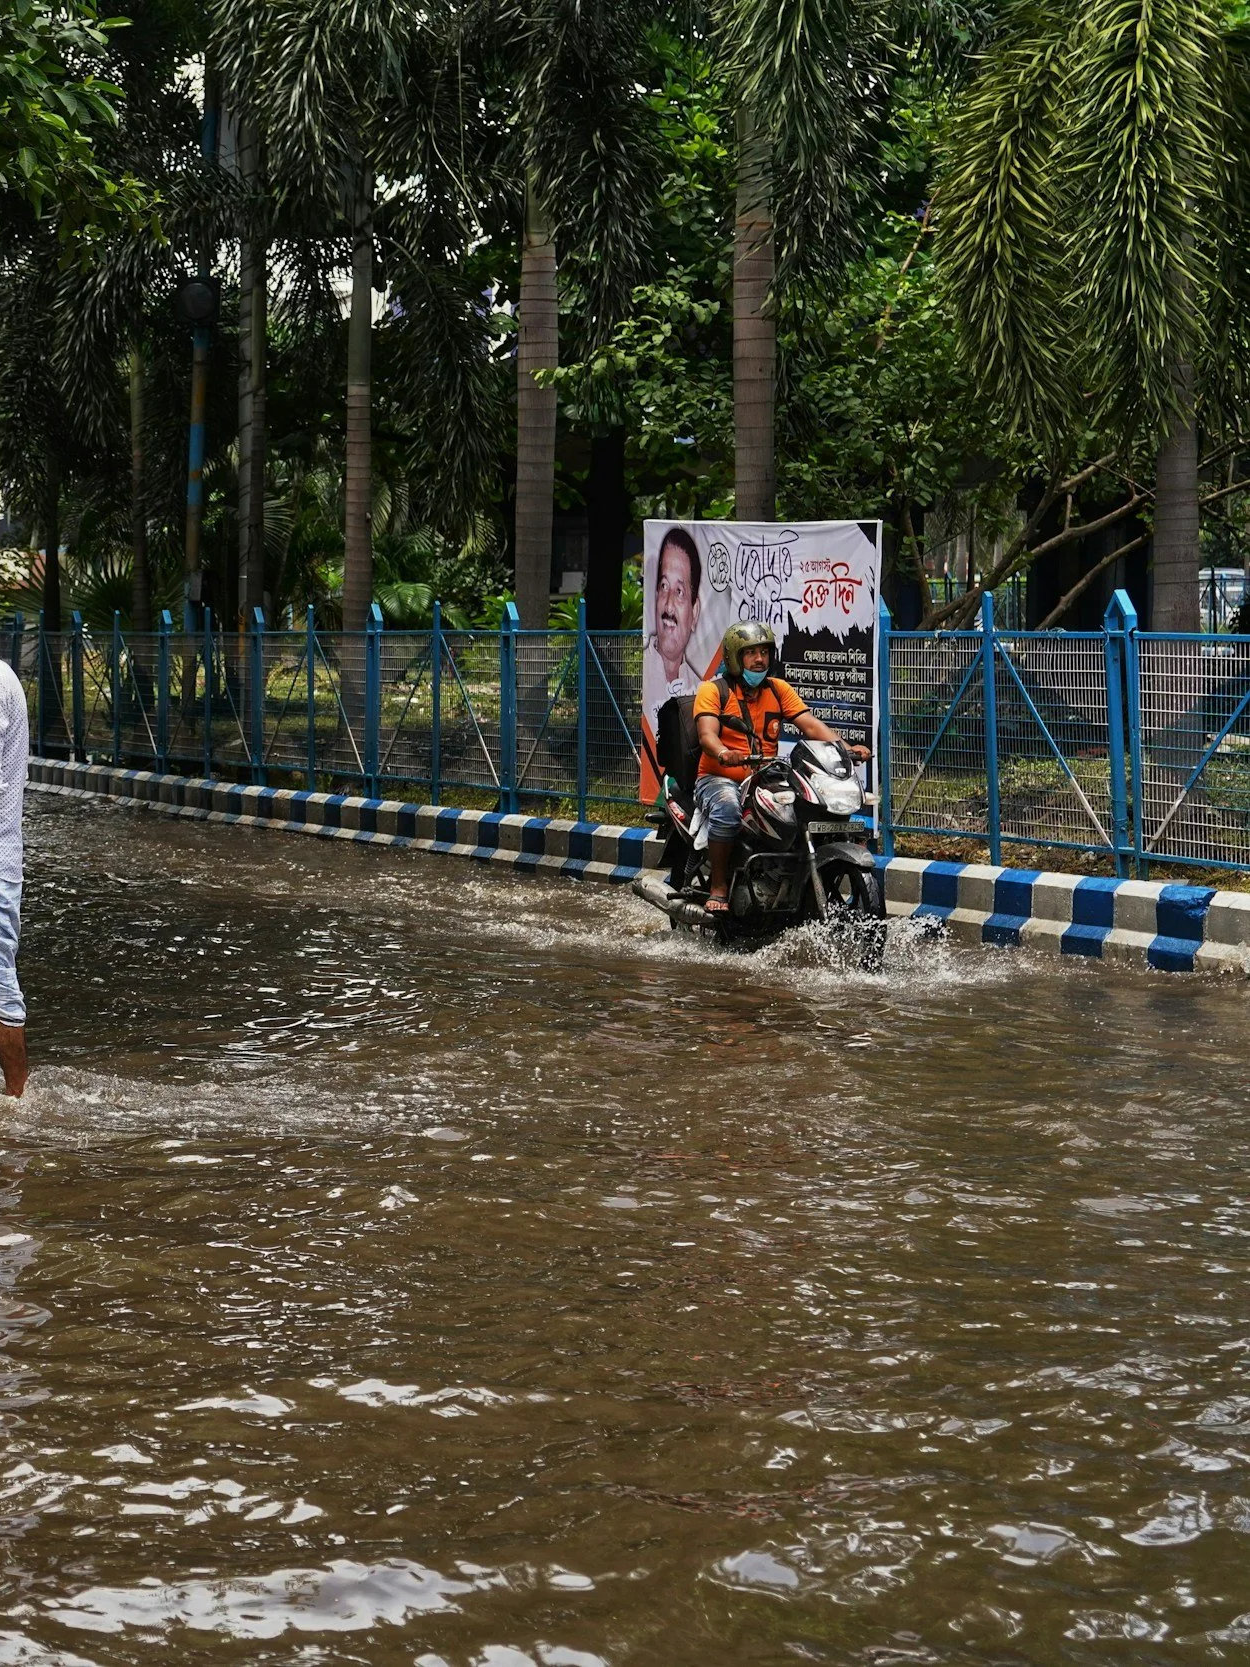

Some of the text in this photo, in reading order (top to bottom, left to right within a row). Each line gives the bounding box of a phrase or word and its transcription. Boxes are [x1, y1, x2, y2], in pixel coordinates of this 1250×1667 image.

[848, 648, 866, 664] শিবির
[785, 664, 812, 682] বিনামূল্যে
[829, 671, 834, 681] ও
[846, 667, 866, 684] পরীক্ষা
[836, 690, 866, 703] অপারেশন
[832, 705, 852, 721] বিতরণ
[853, 711, 866, 722] এবং
